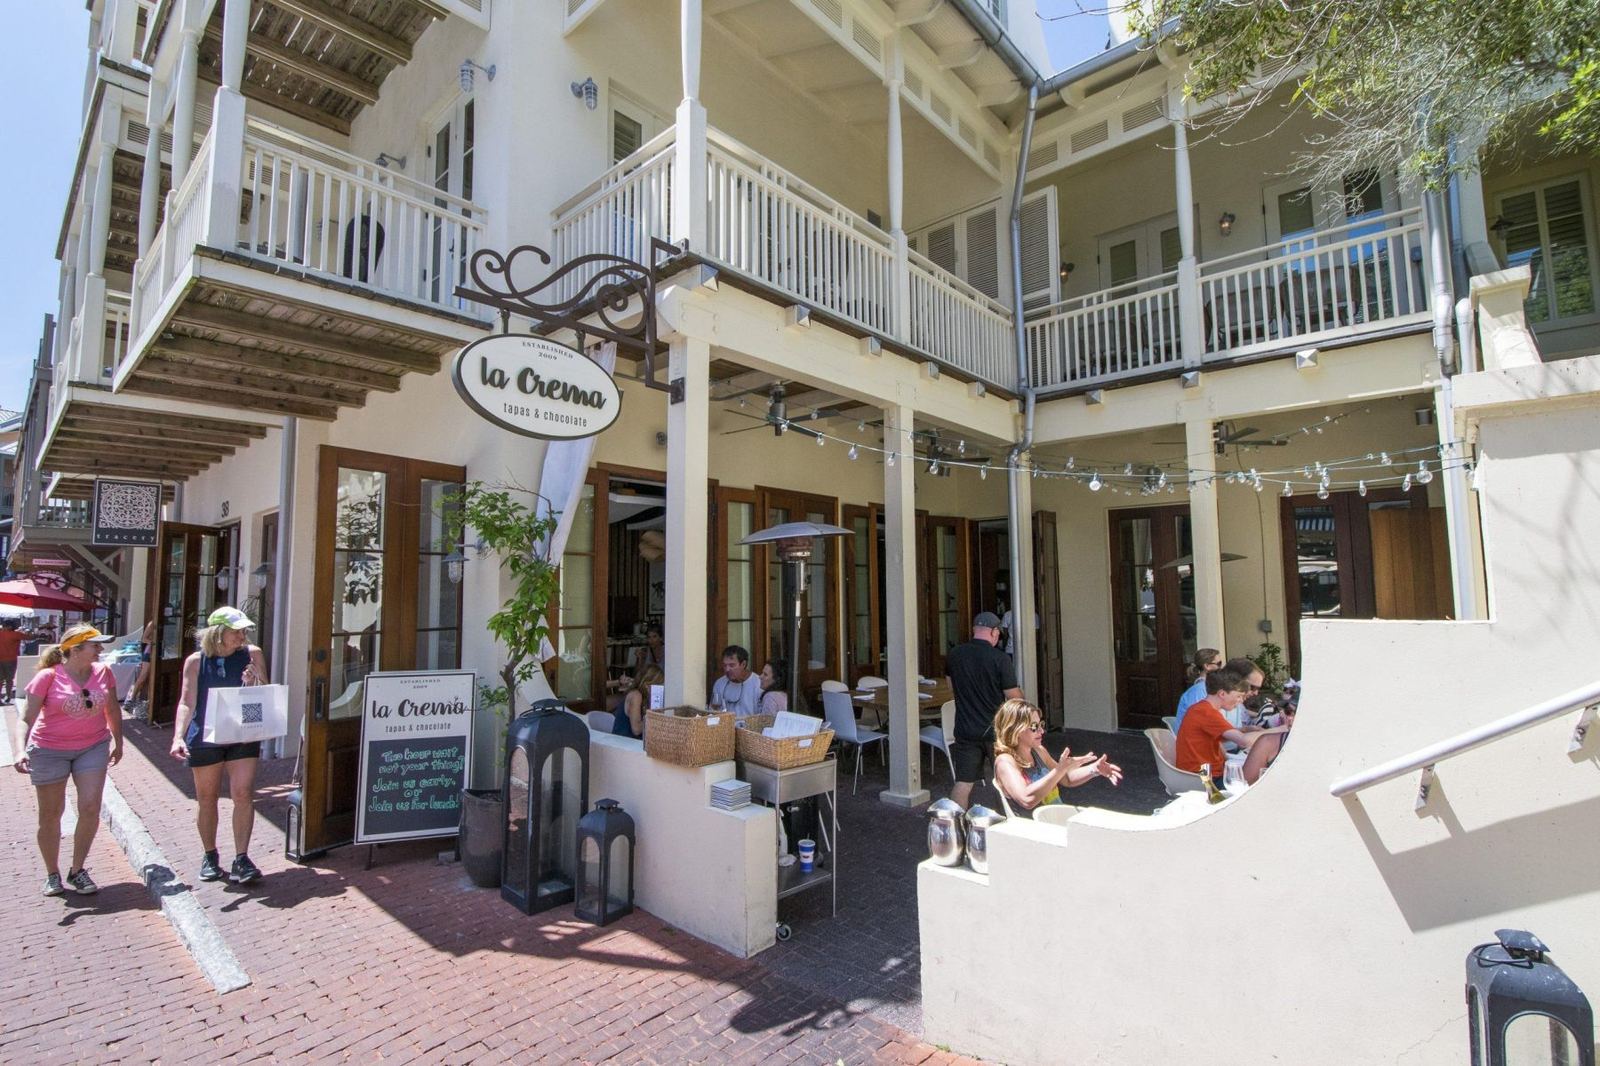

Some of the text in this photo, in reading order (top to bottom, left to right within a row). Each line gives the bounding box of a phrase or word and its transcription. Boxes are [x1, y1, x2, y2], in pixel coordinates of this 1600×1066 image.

[522, 341, 574, 359] ESTABLISHED
[538, 351, 557, 360] 2009
[480, 356, 606, 410] la Crema
[503, 402, 588, 428] tapas & chocolate
[96, 533, 155, 543] tracery
[372, 698, 464, 719] la Crema
[385, 722, 451, 733] tapas & chocolate
[404, 747, 431, 760] hour
[401, 762, 429, 776] your
[372, 778, 399, 792] Join
[403, 779, 416, 789] us
[404, 789, 422, 798] or
[368, 796, 393, 812] Join
[396, 801, 410, 811] us
[410, 796, 428, 810] for
